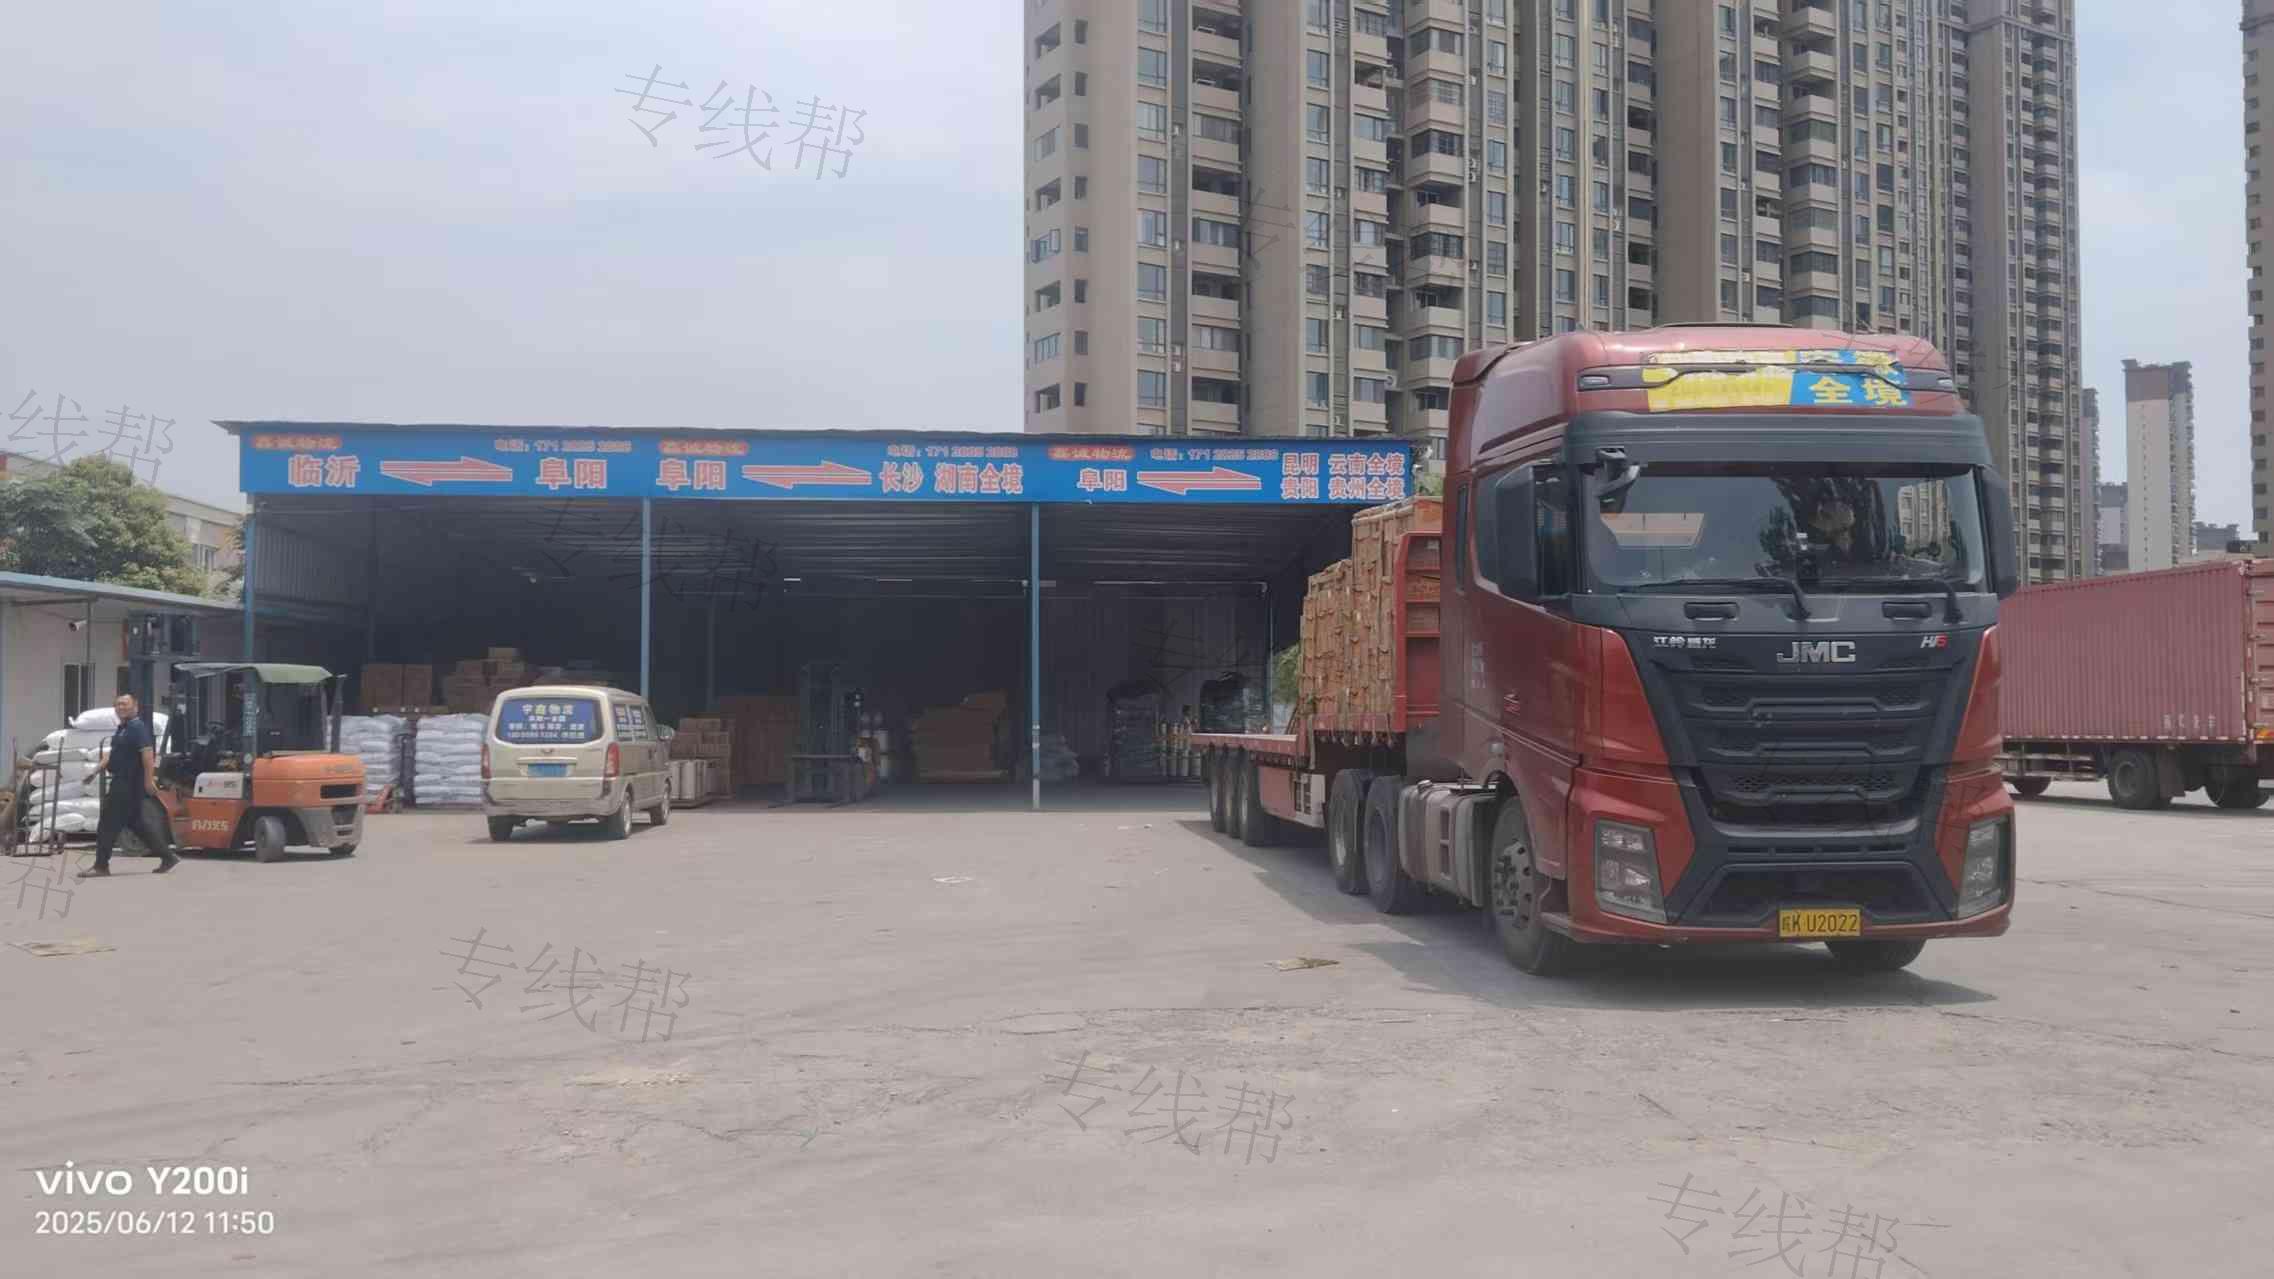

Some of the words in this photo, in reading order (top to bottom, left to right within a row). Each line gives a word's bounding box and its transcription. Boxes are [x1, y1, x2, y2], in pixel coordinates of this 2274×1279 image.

[288, 454, 360, 487] 临沂
[536, 457, 607, 490] 阜阳
[656, 458, 727, 491] 阜阳
[880, 462, 924, 494] 长沙
[934, 462, 1023, 494] 湖南全境
[1282, 452, 1319, 475] 昆明
[1328, 453, 1405, 476] 云南全境
[1077, 467, 1128, 492] 阜阳
[1281, 476, 1319, 499] 贵阳
[1328, 476, 1405, 499] 贵州全境
[1777, 640, 1856, 663] JMC
